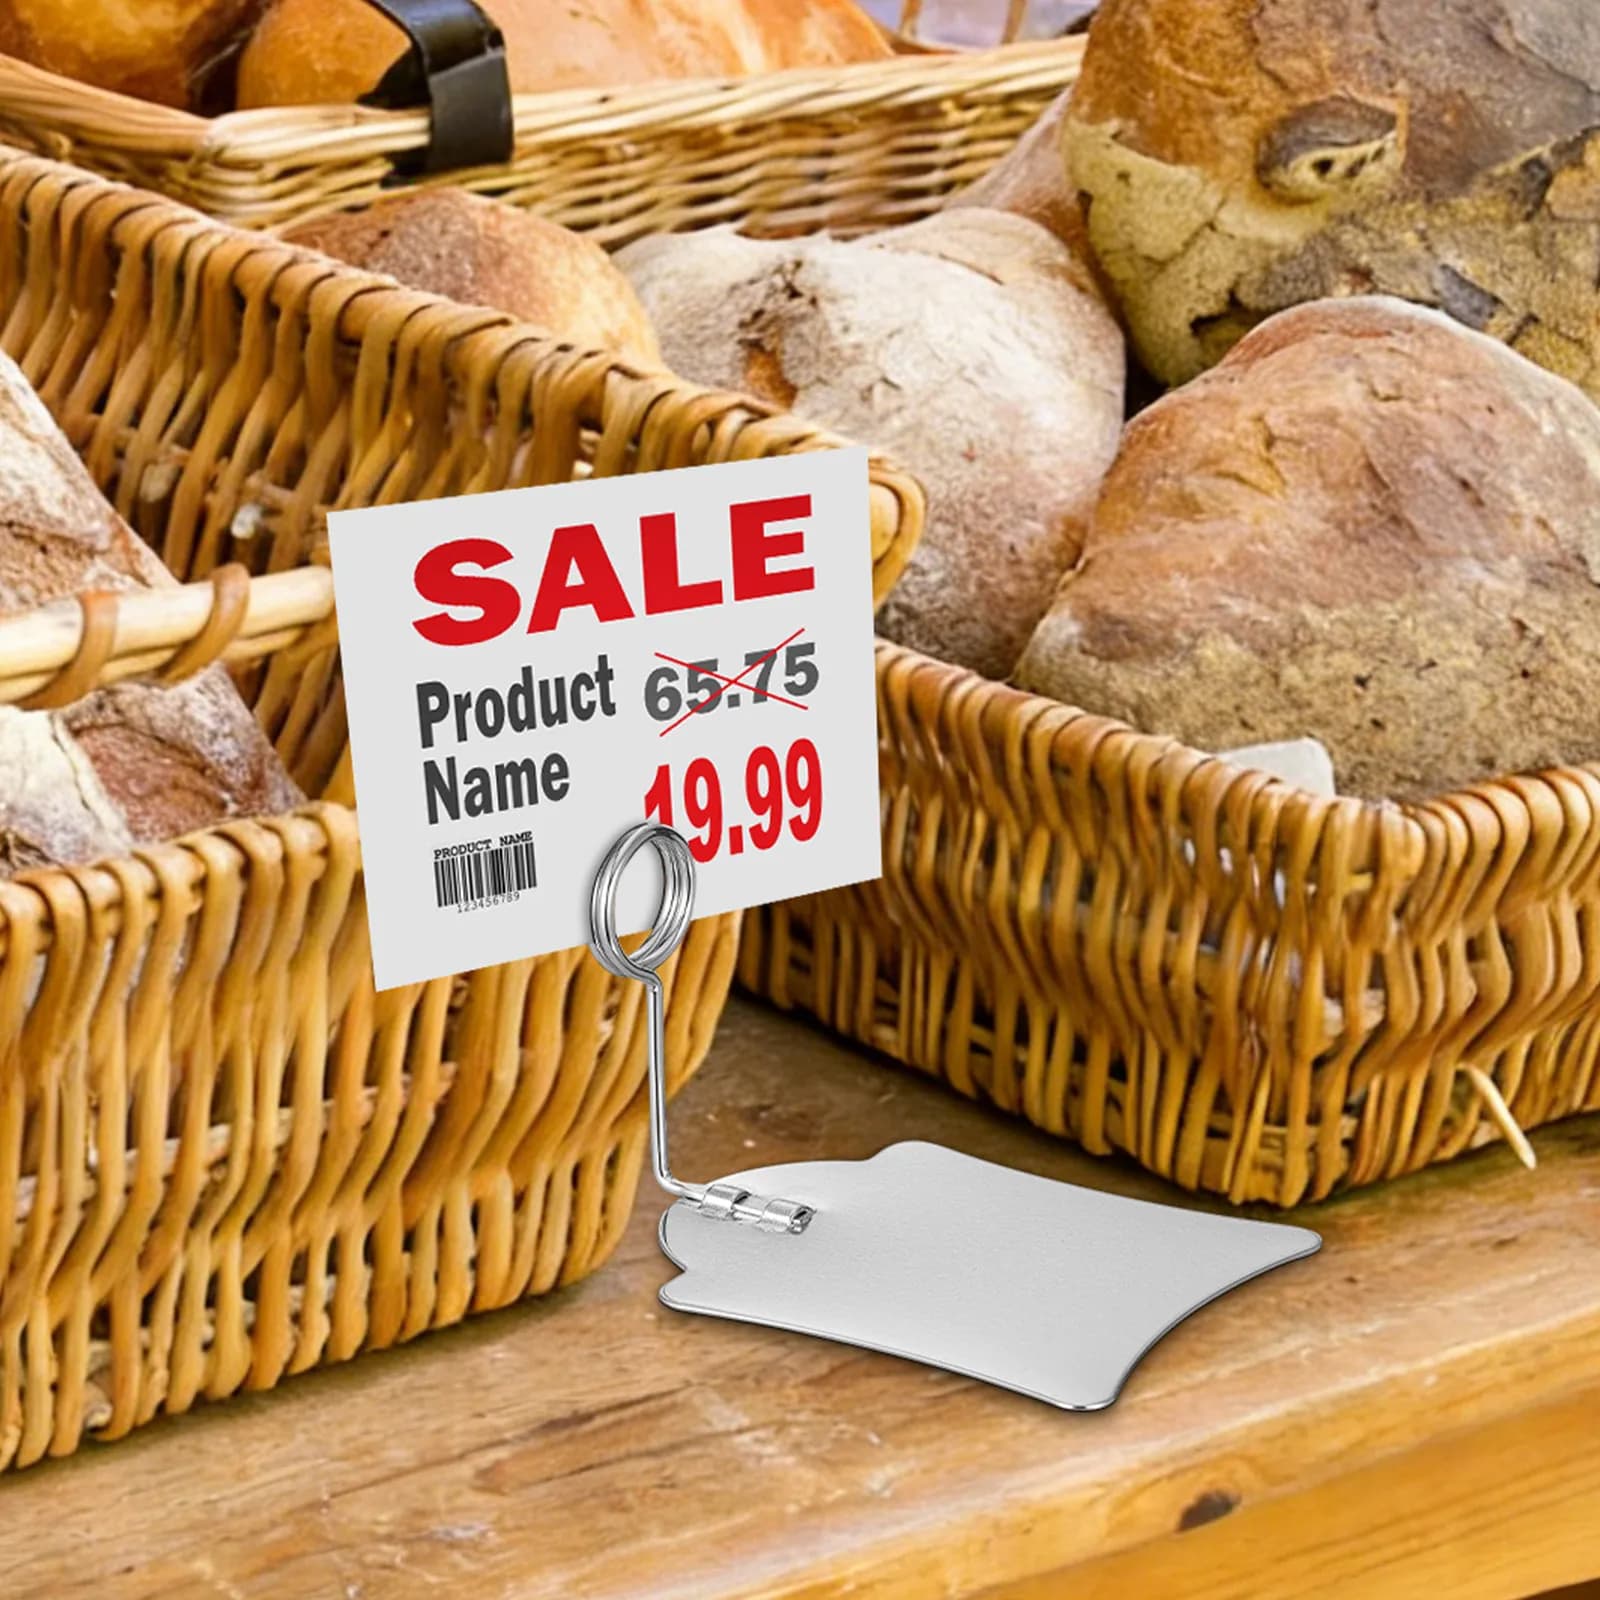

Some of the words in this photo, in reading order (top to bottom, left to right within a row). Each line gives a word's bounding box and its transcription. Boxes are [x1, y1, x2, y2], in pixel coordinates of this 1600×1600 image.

[412, 494, 815, 646] SALE
[416, 654, 616, 749] Product
[644, 642, 820, 721] 65.75
[423, 752, 570, 825] Name
[644, 738, 823, 863] 19.99
[433, 838, 492, 860] PRODUCT
[499, 830, 533, 847] NAME
[457, 891, 520, 914] 123456789
